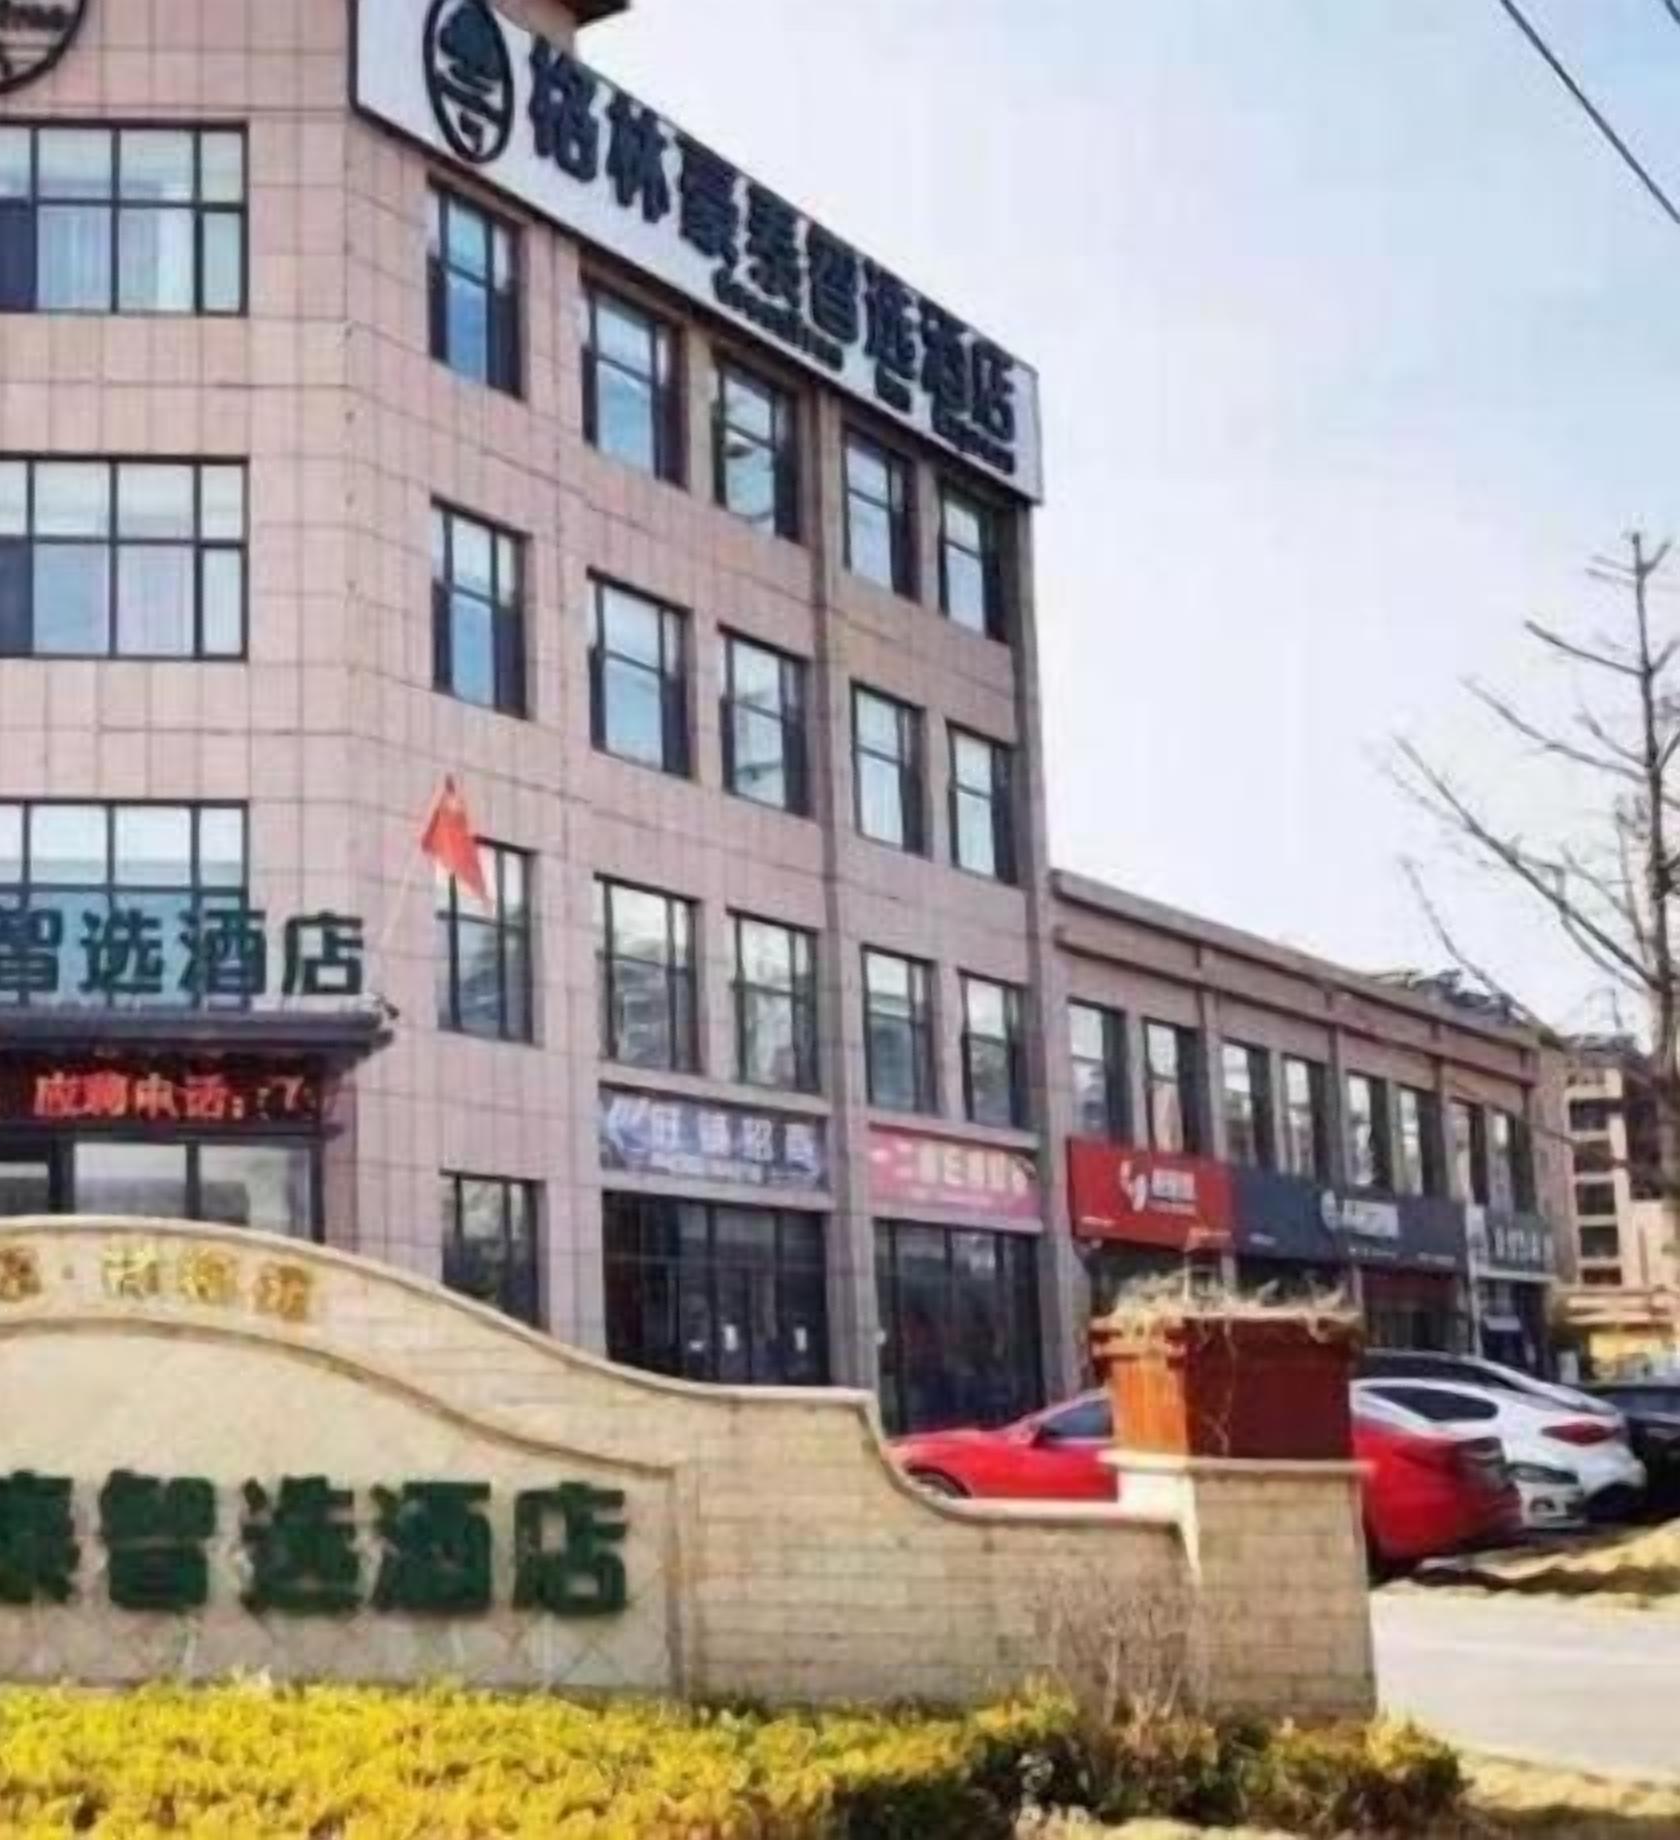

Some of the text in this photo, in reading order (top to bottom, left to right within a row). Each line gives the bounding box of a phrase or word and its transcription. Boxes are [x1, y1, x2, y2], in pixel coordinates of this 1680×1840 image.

[528, 36, 1016, 444] 格林豪泰智选酒店
